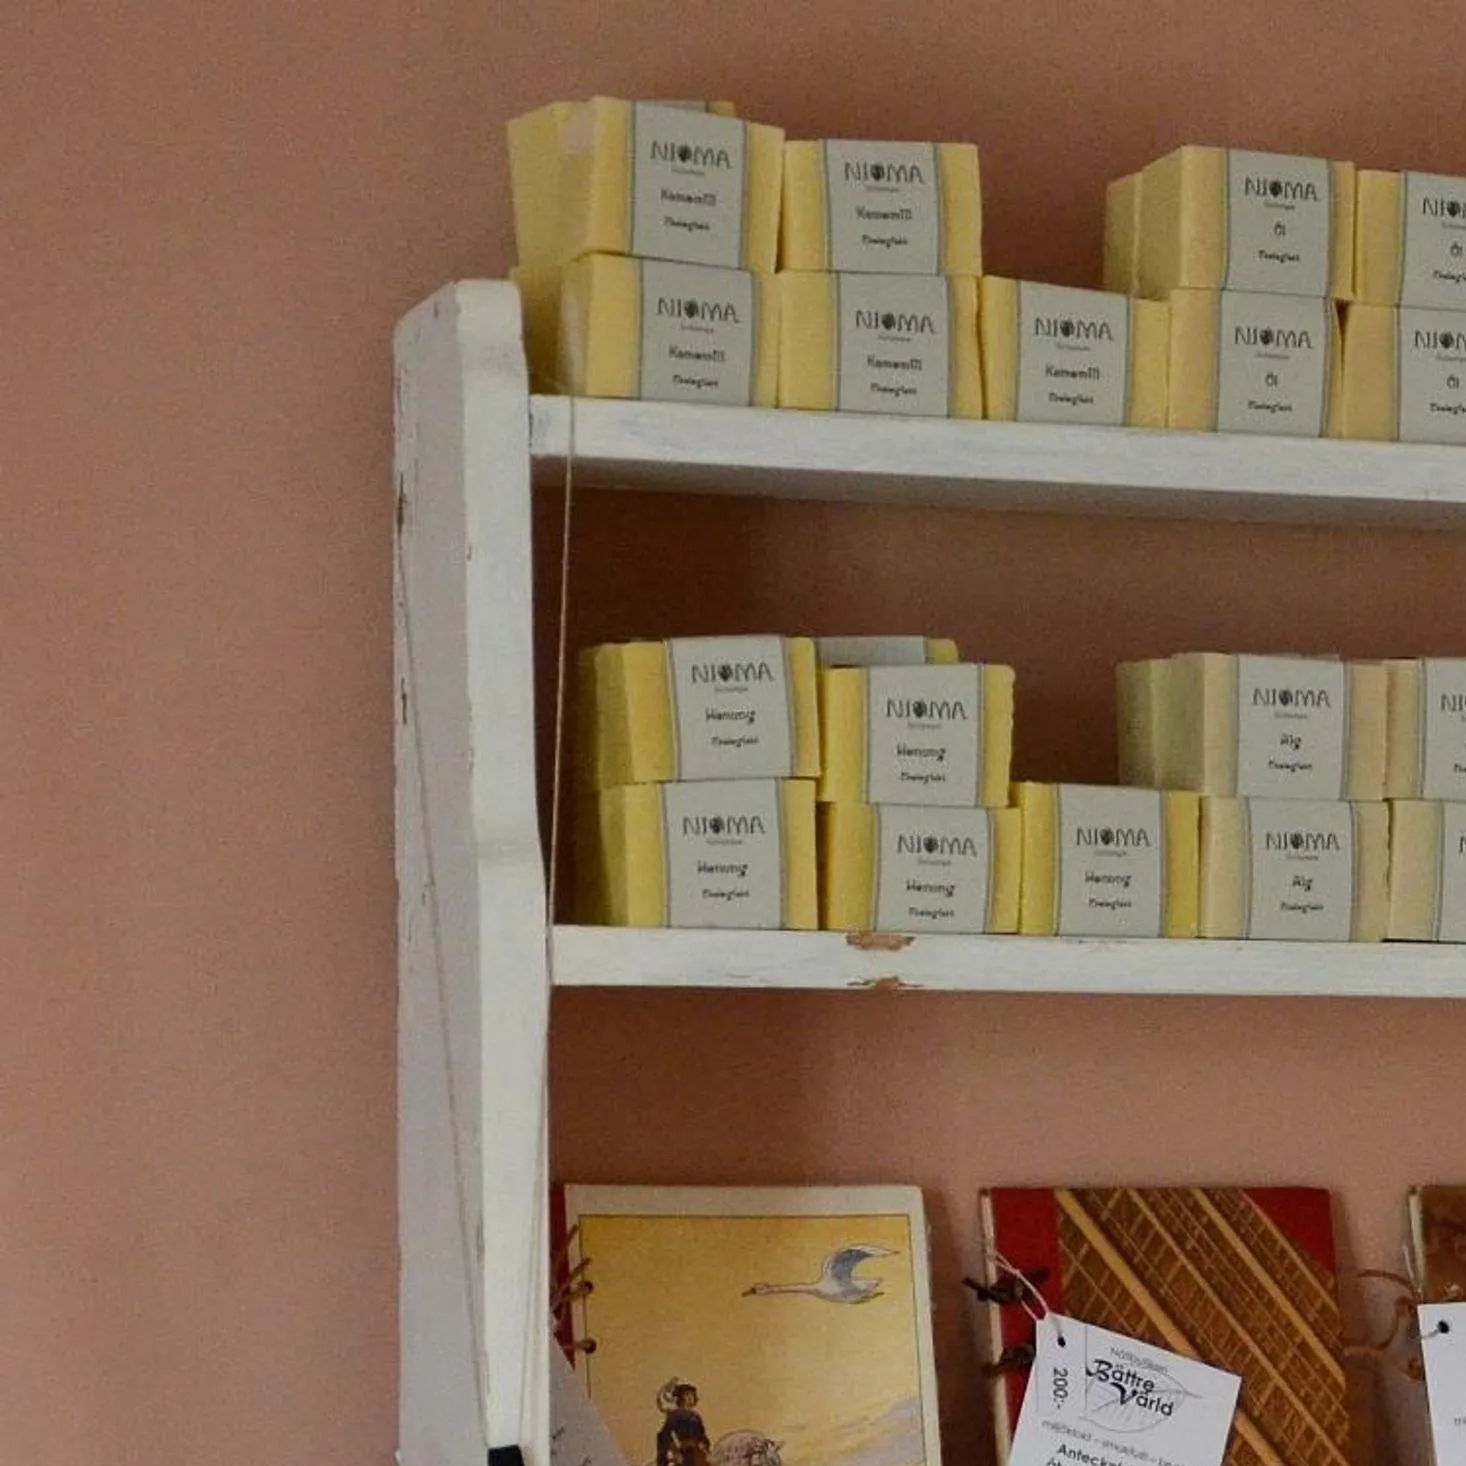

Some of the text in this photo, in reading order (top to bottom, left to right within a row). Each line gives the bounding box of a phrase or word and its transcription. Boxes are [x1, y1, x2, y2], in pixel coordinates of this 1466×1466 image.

[650, 140, 733, 170] NIOMA
[844, 161, 925, 185] NIOMA
[1244, 176, 1319, 202] NIOMA
[657, 297, 740, 324] NIOMA
[855, 309, 937, 334] NIOMA
[1034, 317, 1114, 341] NIOMA
[1234, 326, 1313, 349] NIOMA
[691, 662, 775, 683] NIOMA
[887, 699, 968, 720] NIOMA
[1251, 687, 1331, 709] NIOMA
[681, 815, 767, 836] NIOMA
[896, 835, 978, 858] NIOMA
[1076, 827, 1150, 848] NIOMA
[1265, 832, 1341, 852] NIOMA
[1085, 1359, 1155, 1393] Bättre
[1109, 1382, 1174, 1416] Värld
